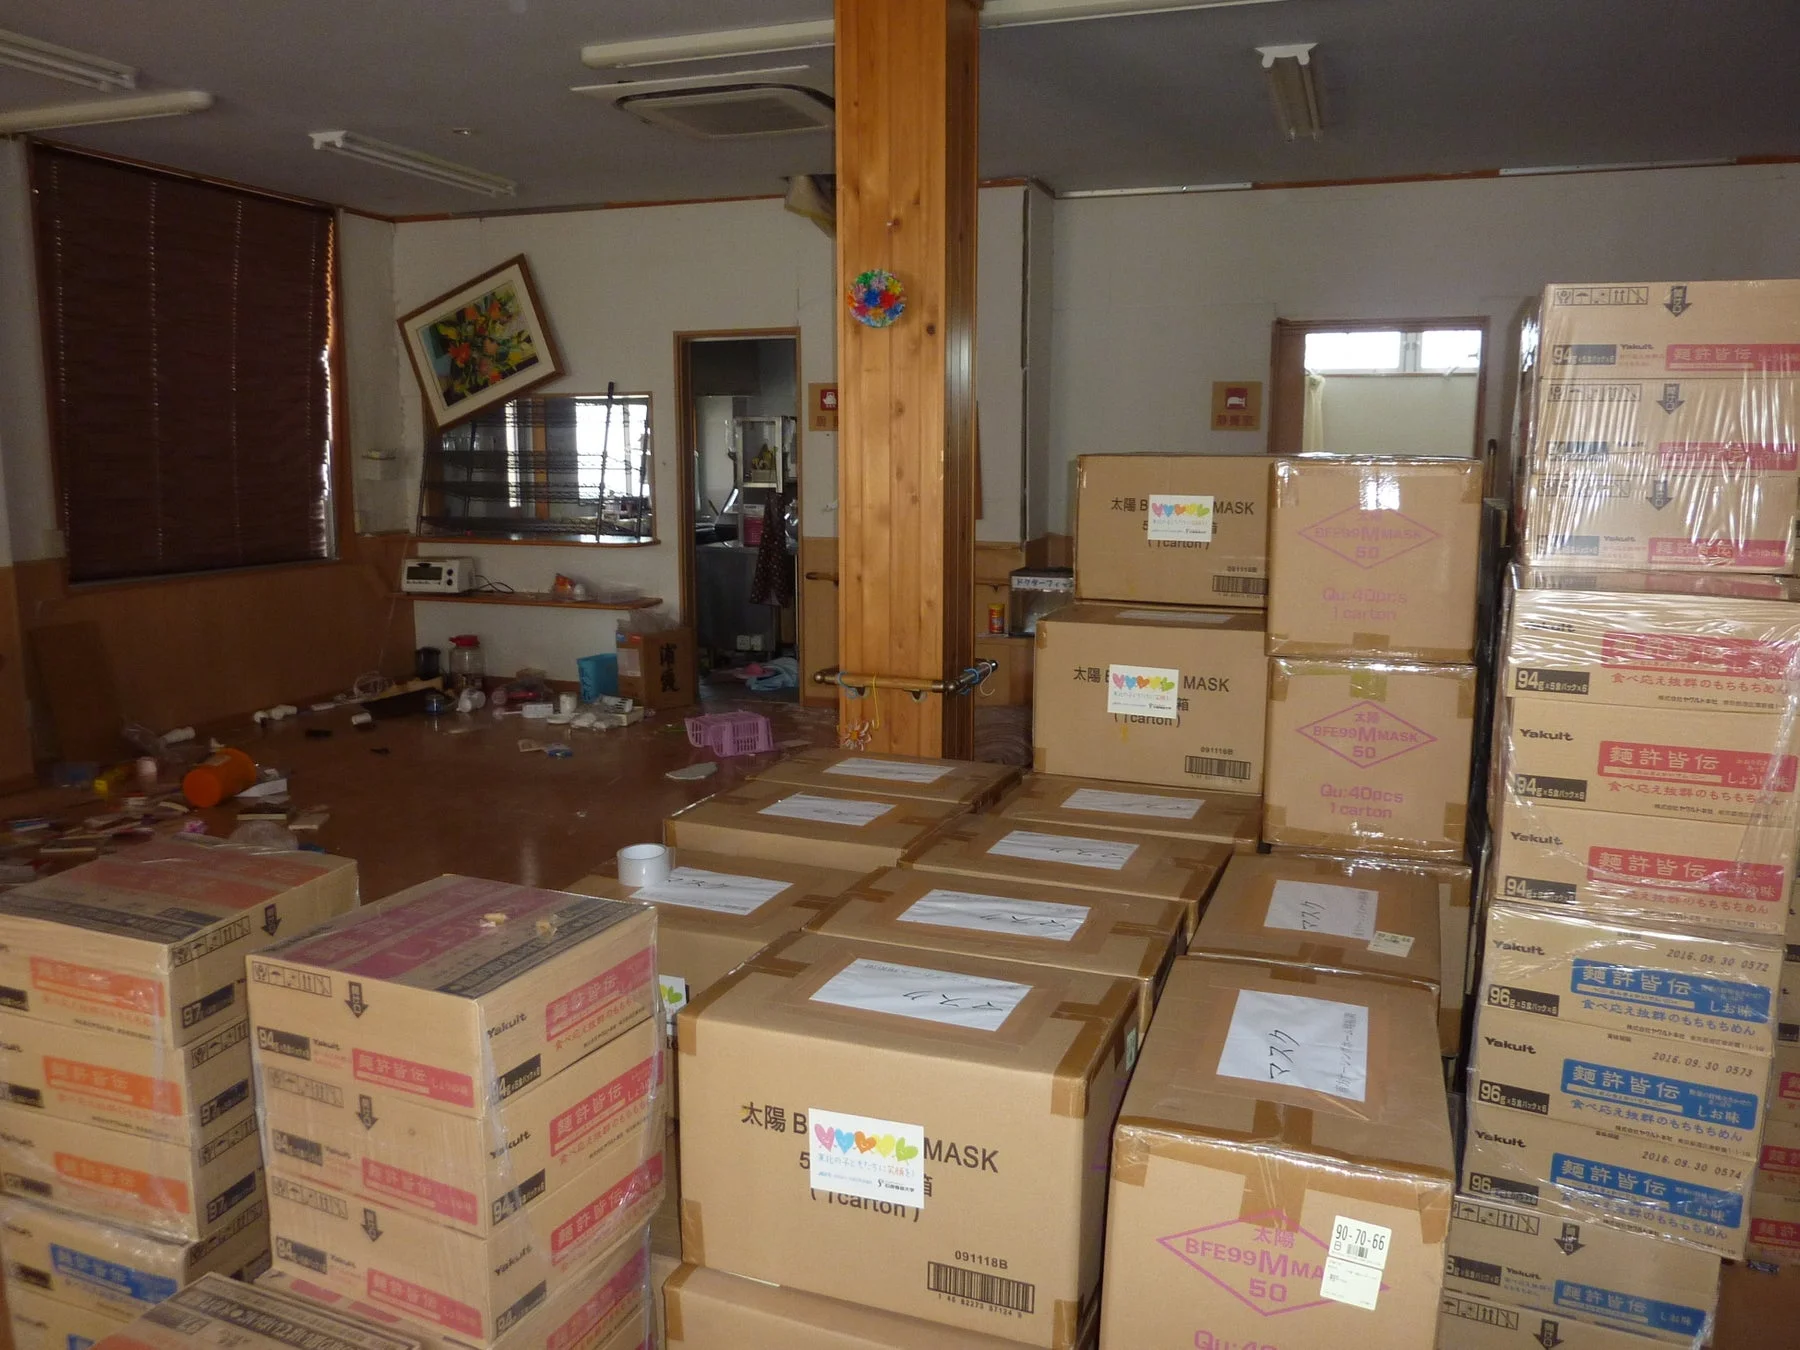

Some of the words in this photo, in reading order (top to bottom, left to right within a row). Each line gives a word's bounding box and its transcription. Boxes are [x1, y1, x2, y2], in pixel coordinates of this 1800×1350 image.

[1213, 502, 1254, 515] MASK
[1073, 667, 1100, 683] 太陽
[1184, 675, 1230, 692] MASK
[1520, 729, 1573, 741] Yakult
[1352, 746, 1376, 758] 50
[1511, 832, 1563, 845] Yakult
[1493, 940, 1545, 955] Yakult
[487, 1013, 527, 1039] Yakult
[1269, 1029, 1300, 1080] マスク
[1485, 1037, 1536, 1054] Yakult
[1573, 1065, 1680, 1100] 麺許皆伝
[1698, 1105, 1740, 1124] しお味
[741, 1101, 785, 1132] 太陽
[924, 1137, 999, 1173] MASK
[1475, 1130, 1526, 1148] Yakult
[1562, 1159, 1667, 1196] 麺許皆伝
[1253, 1227, 1295, 1249] 太陽
[1336, 1224, 1385, 1250] 90-70-66
[955, 1250, 1009, 1270] 091118B
[1291, 1260, 1324, 1280] MA
[1249, 1277, 1287, 1302] 50
